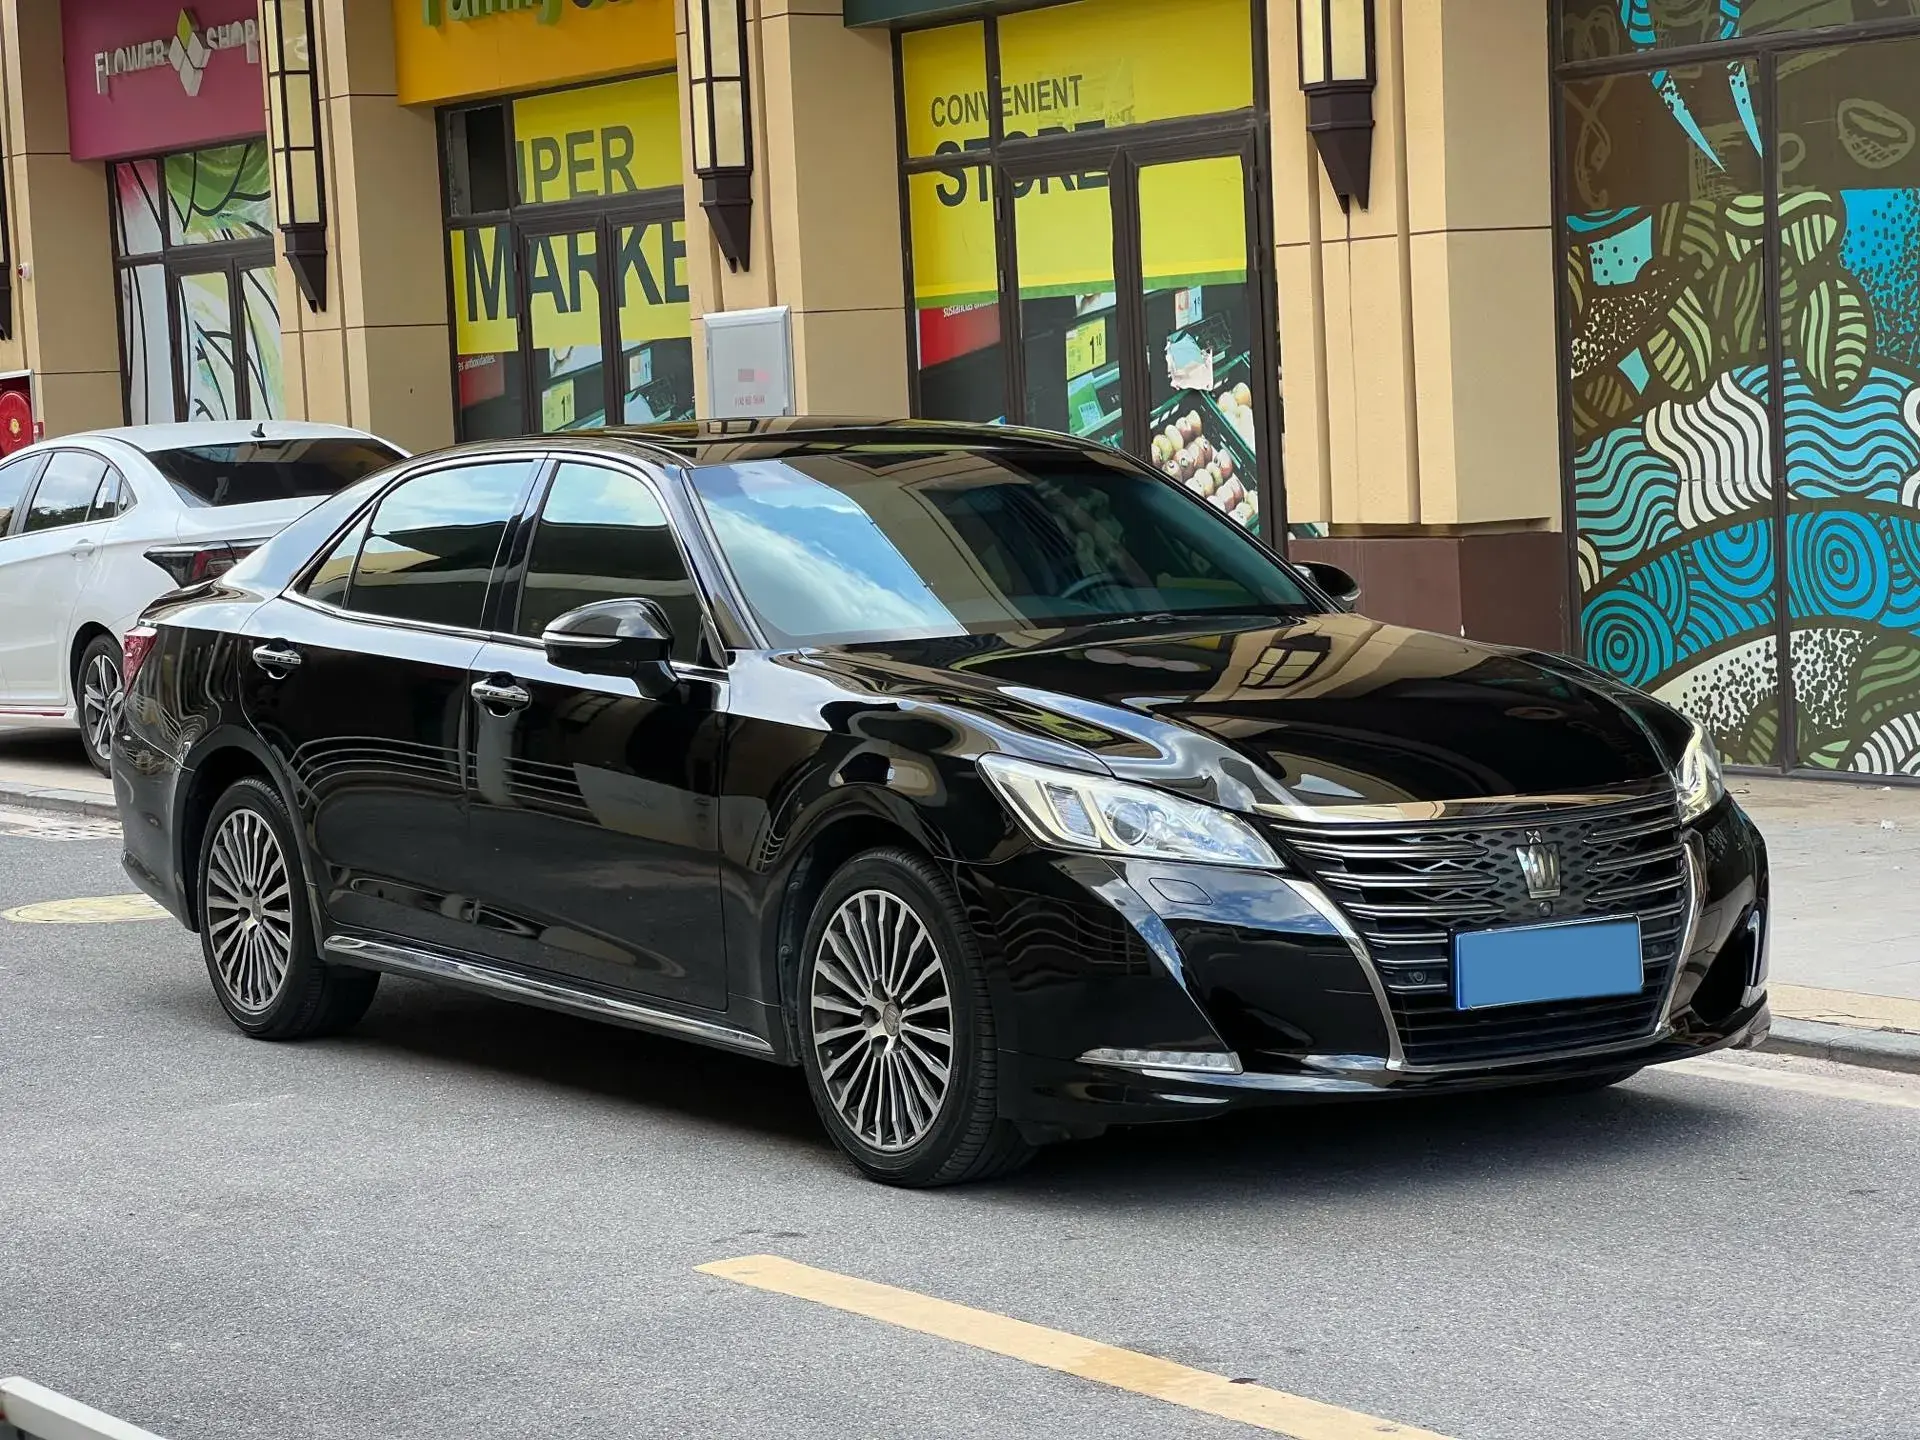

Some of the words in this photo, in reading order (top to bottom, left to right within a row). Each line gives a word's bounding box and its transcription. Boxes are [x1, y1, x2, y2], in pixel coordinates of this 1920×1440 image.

[95, 39, 167, 94] FLOWER
[206, 18, 259, 64] SHOP
[931, 74, 1083, 127] CONVENIENT
